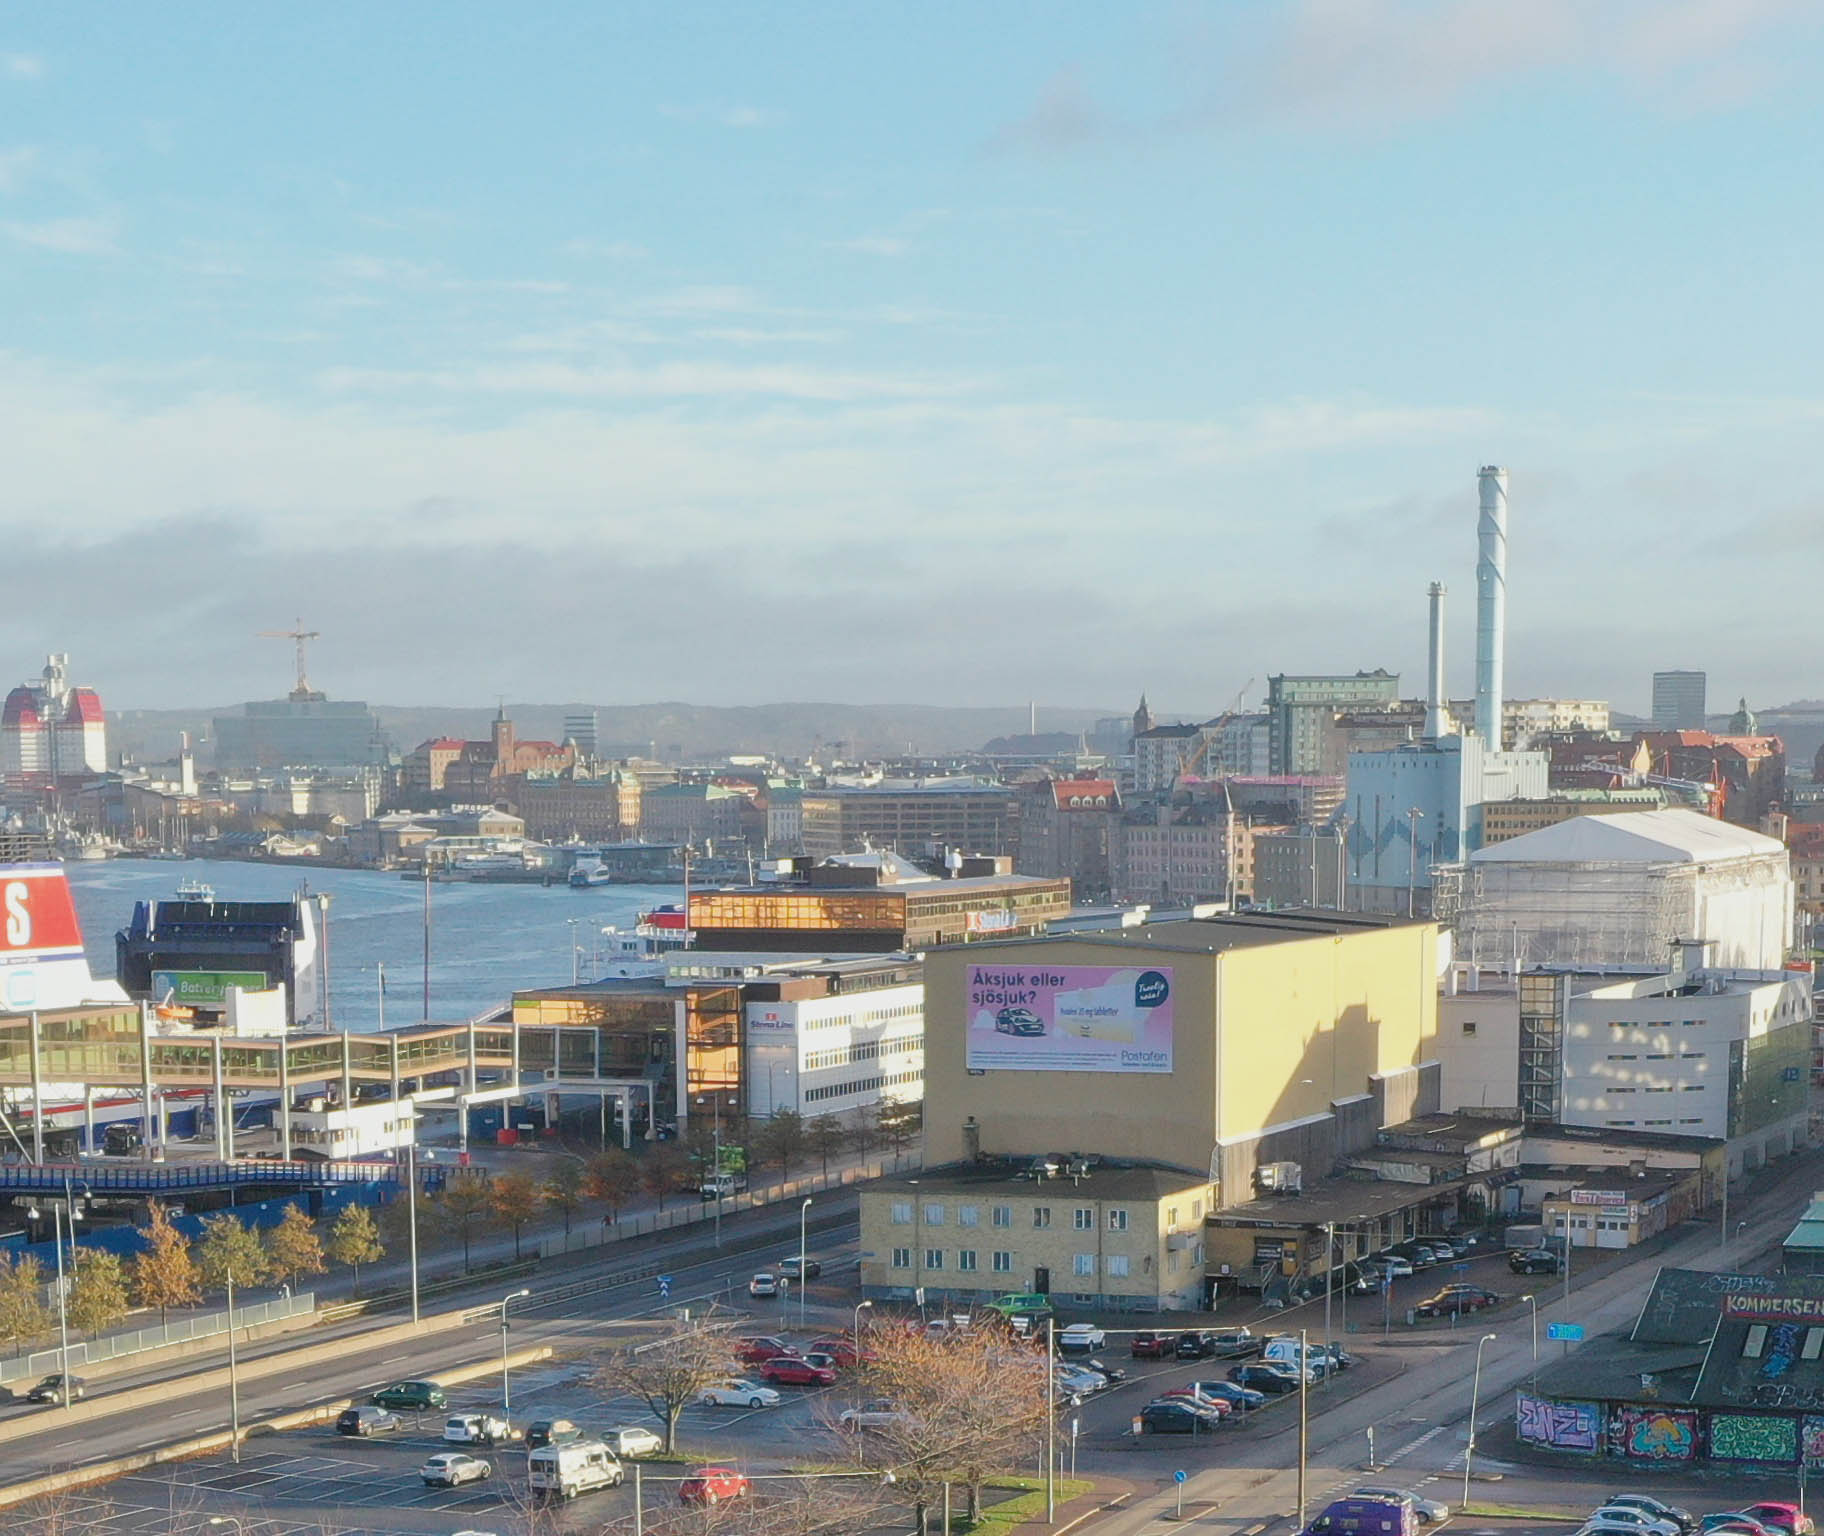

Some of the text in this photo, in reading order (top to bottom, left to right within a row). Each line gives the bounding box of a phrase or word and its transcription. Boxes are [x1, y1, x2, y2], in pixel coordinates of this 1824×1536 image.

[5, 881, 33, 947] S
[972, 972, 1066, 989] Åksjuk eller
[972, 990, 1037, 1006] sjösjuk?
[1120, 1050, 1168, 1062] Postafen
